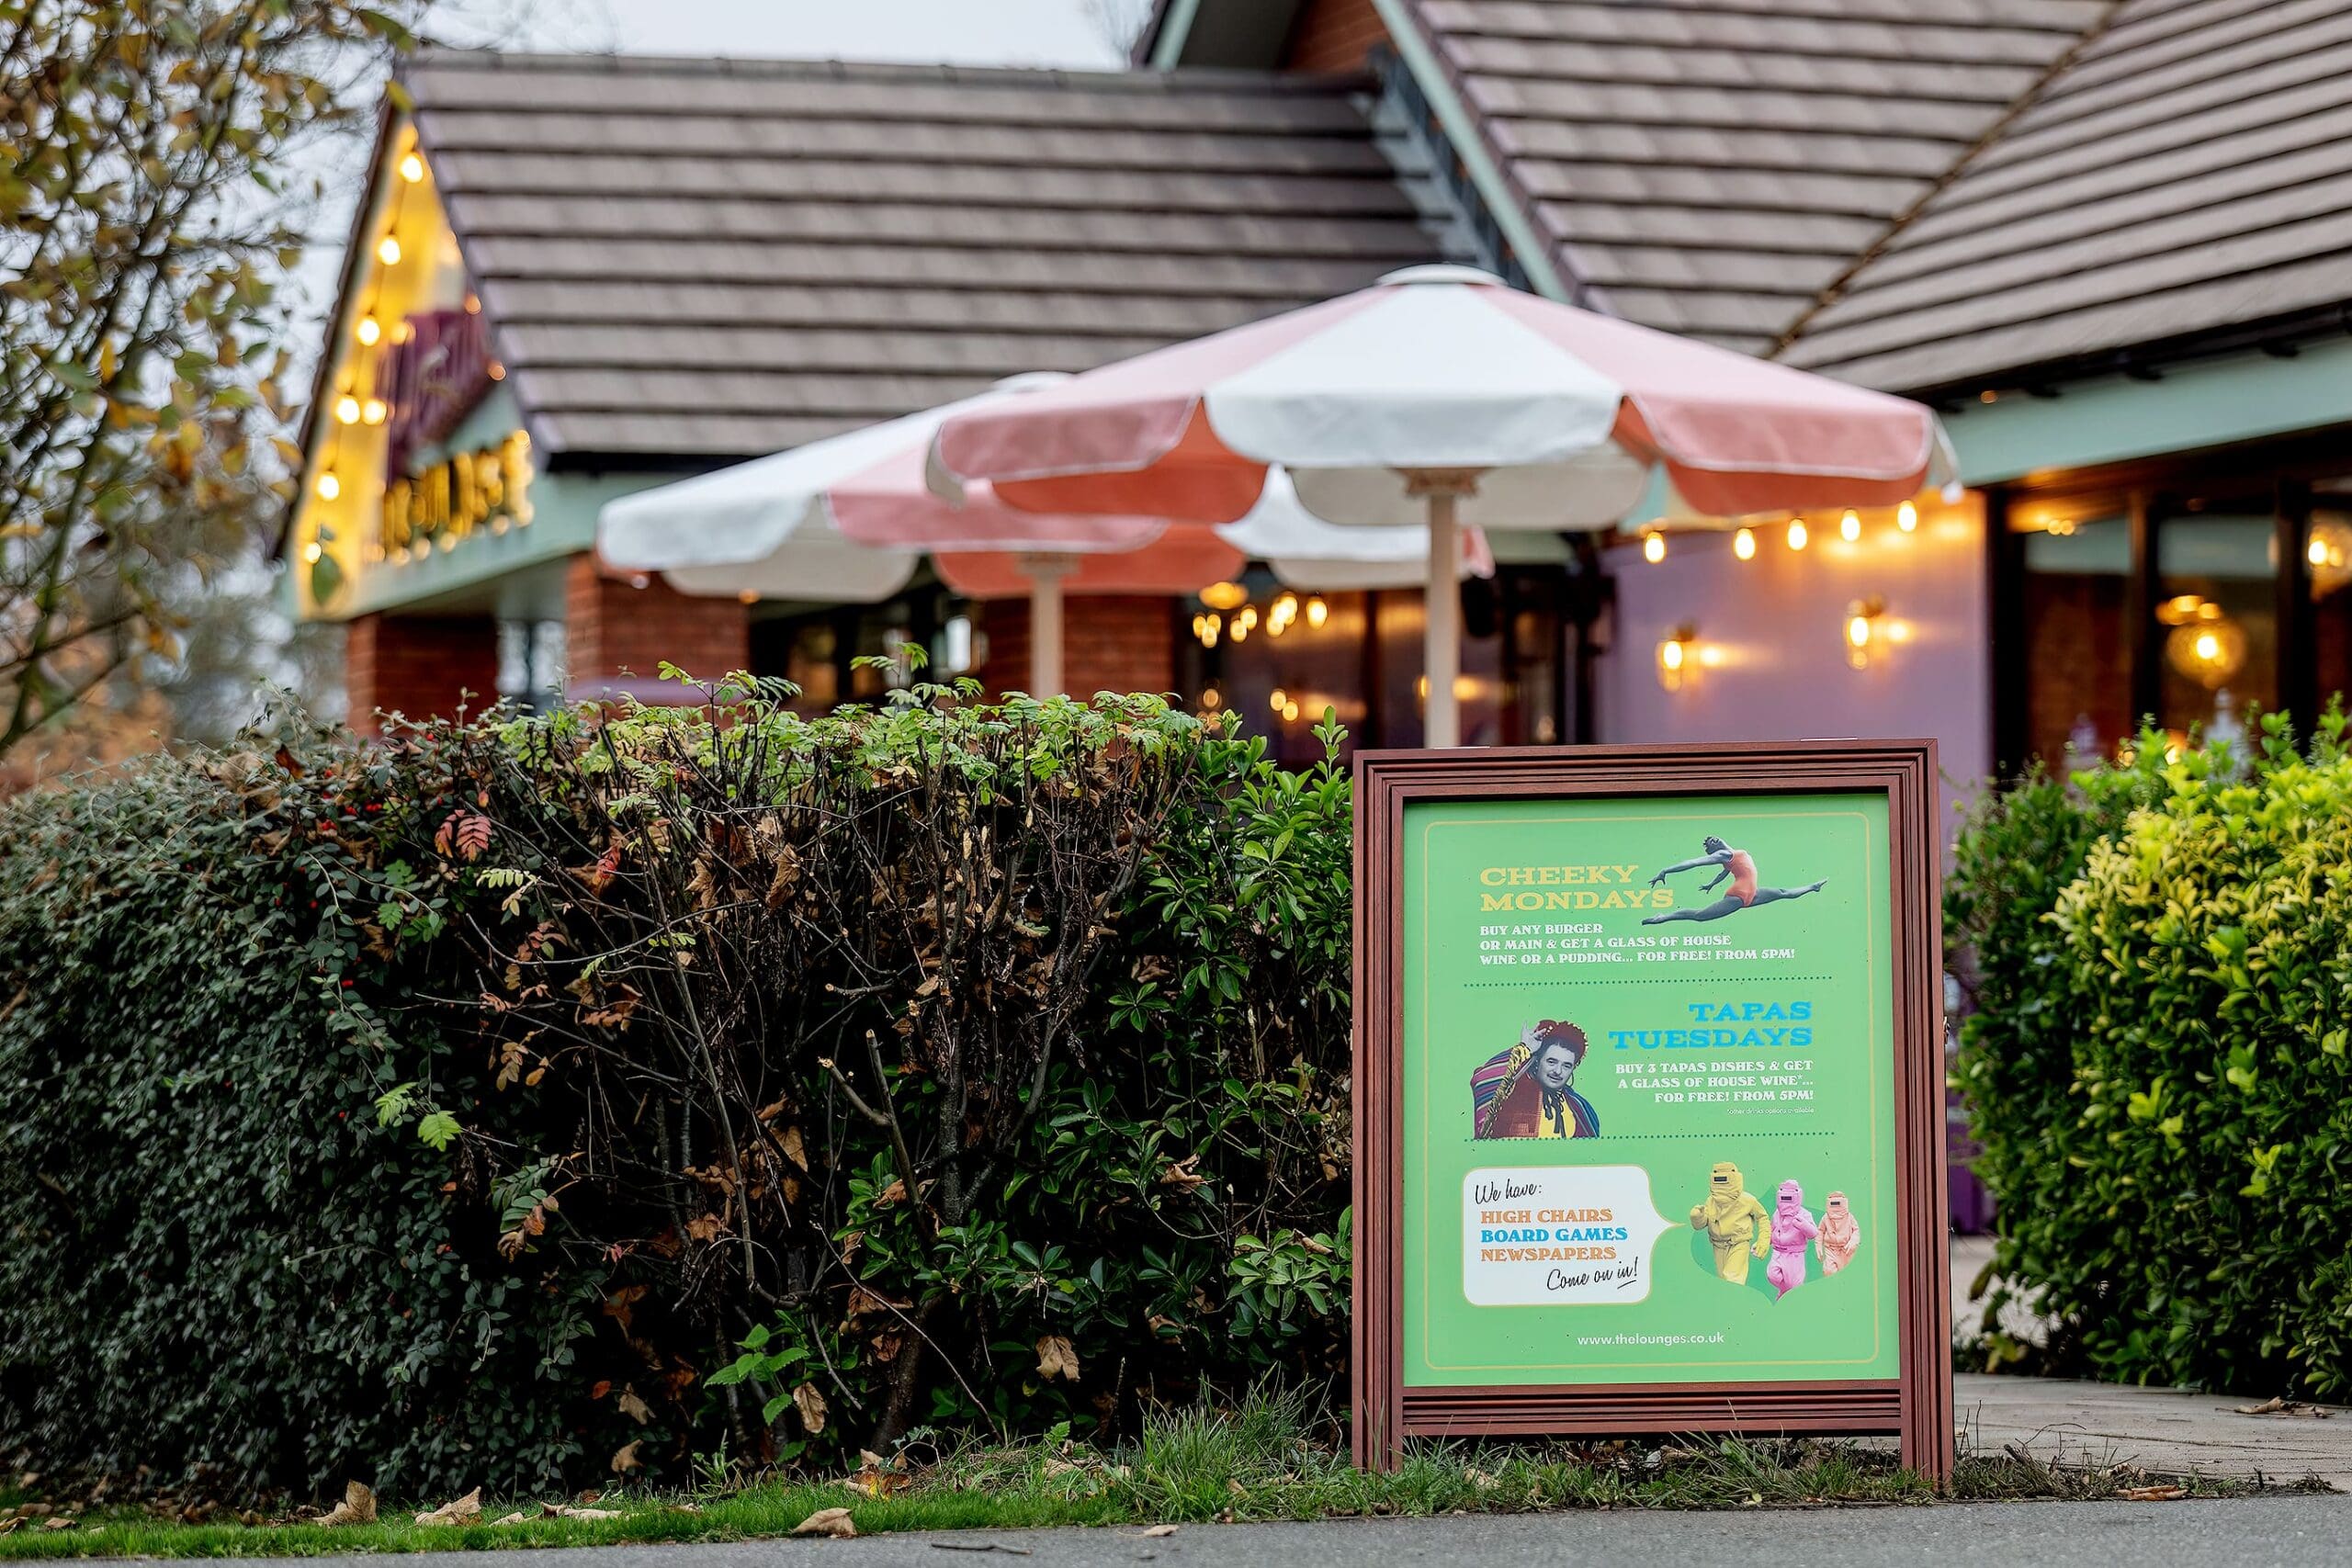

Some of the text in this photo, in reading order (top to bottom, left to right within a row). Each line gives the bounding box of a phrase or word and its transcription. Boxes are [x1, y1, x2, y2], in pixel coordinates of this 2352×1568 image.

[1480, 865, 1639, 886] CHEEKY
[1480, 889, 1674, 912] MONDAYS
[1480, 923, 1603, 936] BUY ANY BURGER
[1480, 935, 1732, 951] OR MAIN & GET A GLASS OF HOUSE
[1480, 954, 1517, 965] WINE
[1521, 953, 1542, 964] OR
[1545, 953, 1555, 964] A
[1637, 951, 1667, 962] FOR
[1670, 951, 1712, 961] FREE!
[1715, 949, 1758, 960] FROM
[1761, 948, 1795, 959] 5PM!
[1689, 1001, 1813, 1022] TAPAS
[1608, 1027, 1813, 1049] TUESDAYS
[1615, 1060, 1814, 1074] BUY 3 TAPAS DISHES & GET
[1618, 1078, 1628, 1089] A
[1632, 1077, 1680, 1089] GLASS
[1684, 1077, 1704, 1088] OF
[1707, 1077, 1757, 1088] HOUSE
[1655, 1089, 1814, 1103] FOR FREE! FROM 5PM!
[1475, 1179, 1543, 1205] We have:
[1481, 1208, 1613, 1224] HIGH CHAIRS
[1481, 1227, 1628, 1243] BOARD GAMES
[1481, 1246, 1617, 1261] NEWSPAPERS
[1546, 1256, 1639, 1291] Come on in!
[1577, 1331, 1724, 1347] www.thelounges.co.uk
